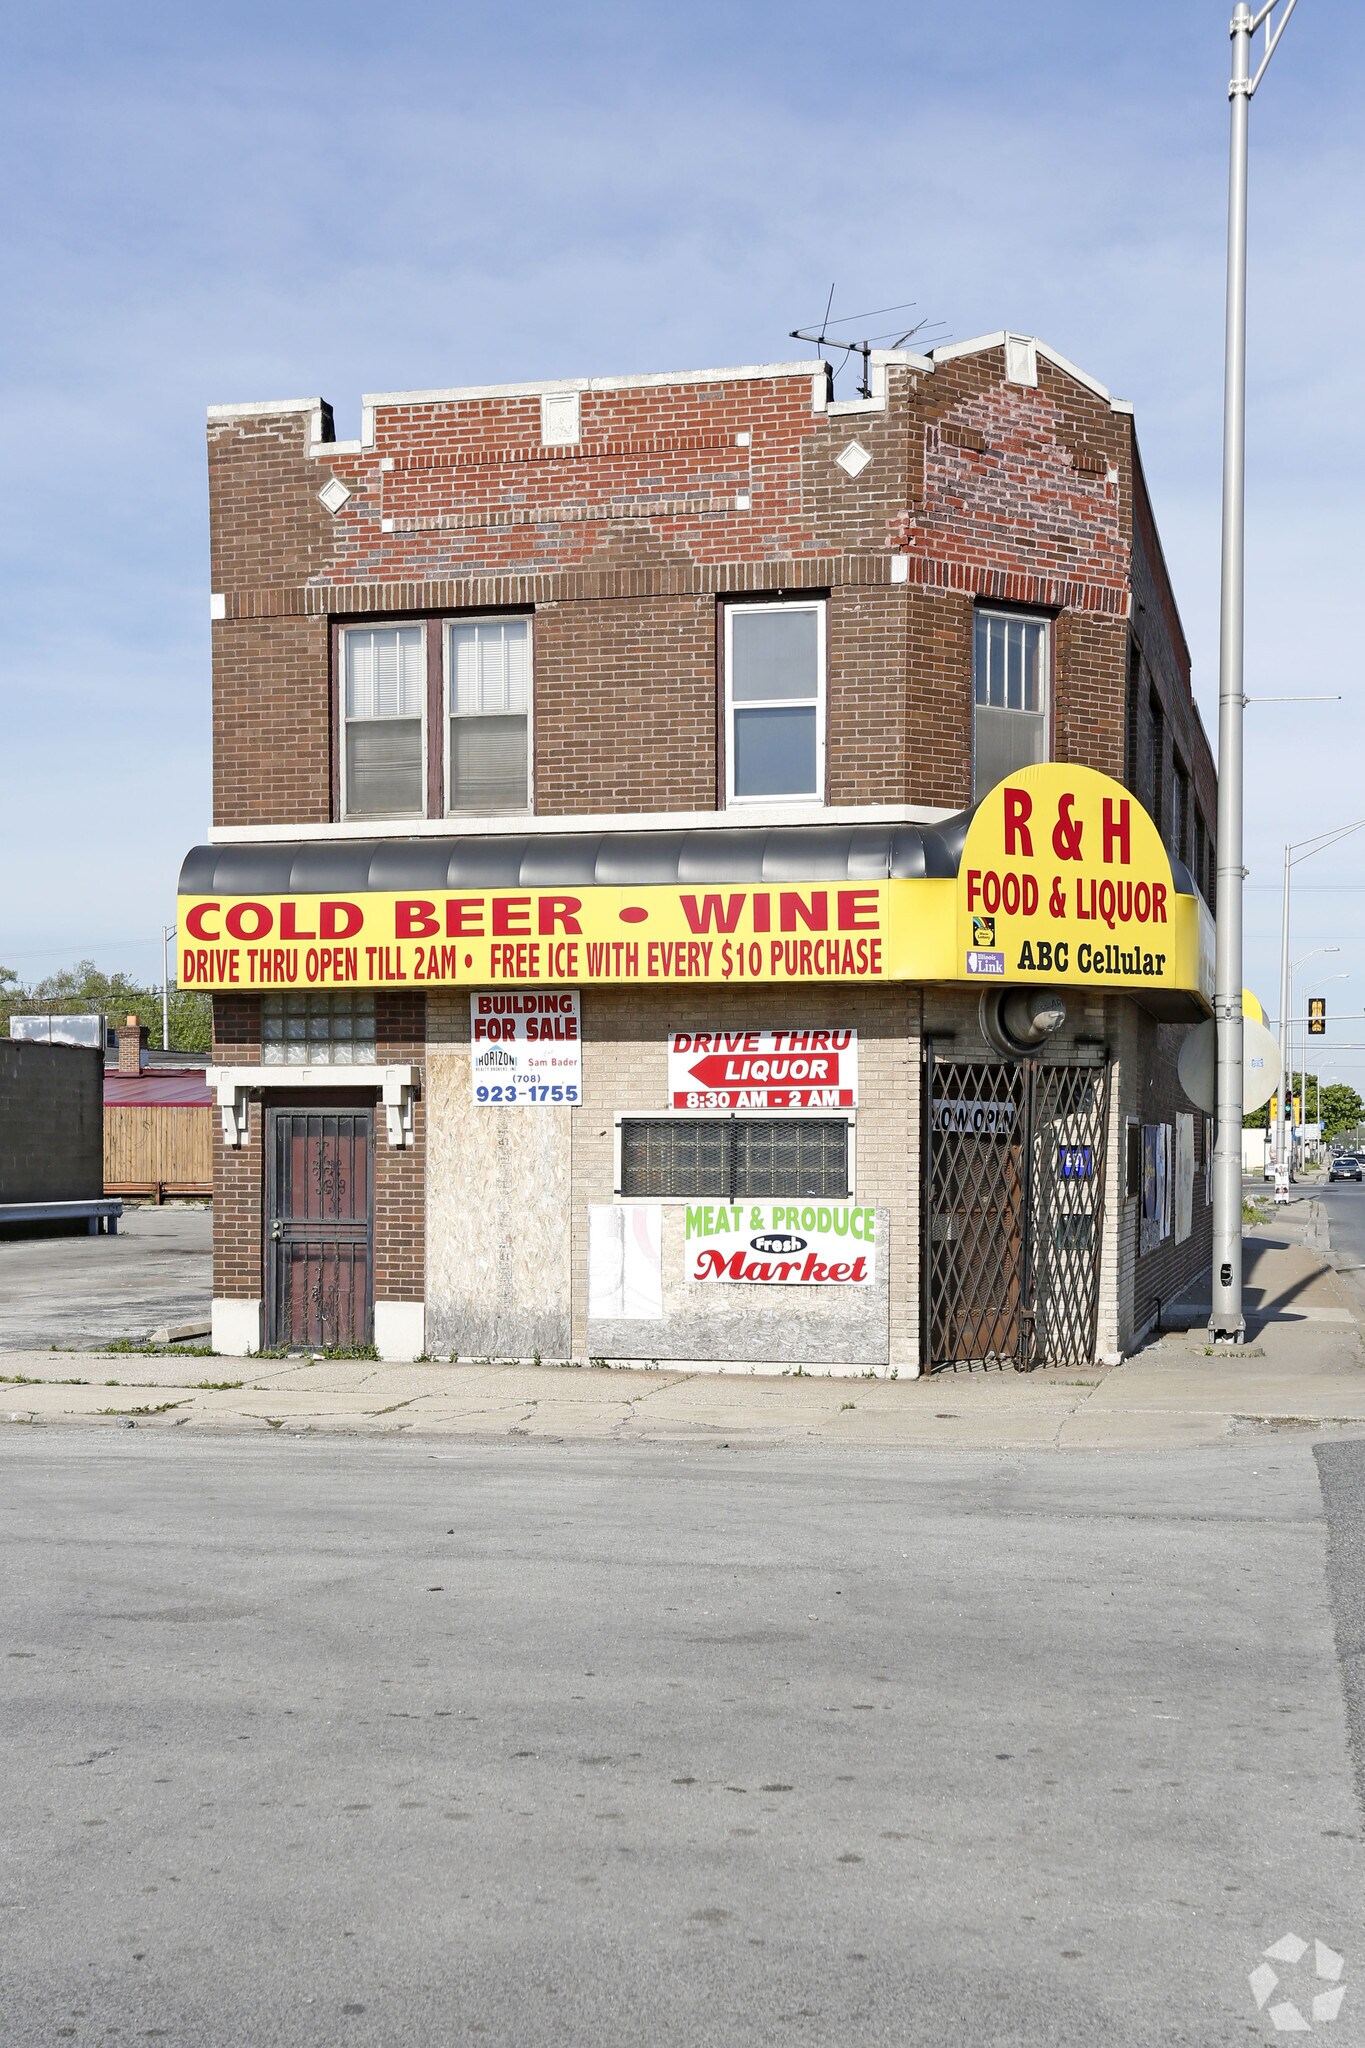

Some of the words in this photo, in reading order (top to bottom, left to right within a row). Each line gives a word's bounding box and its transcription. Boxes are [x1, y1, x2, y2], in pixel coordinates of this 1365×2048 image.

[1004, 788, 1034, 857] R
[1052, 793, 1083, 861] &
[1102, 798, 1130, 864] H
[967, 869, 1039, 916] FOOD
[1049, 876, 1066, 918] &
[1076, 878, 1167, 930] LIQUOR
[185, 901, 364, 941] COLD
[395, 896, 583, 939] BEER
[679, 889, 880, 934] WINE
[184, 949, 239, 982] DRIVE
[247, 949, 298, 982] THRU
[306, 947, 358, 982] OPEN
[365, 946, 407, 981] TILL
[414, 945, 456, 980] 2AM
[490, 943, 540, 978] FREE
[548, 942, 578, 977] ICE
[586, 942, 639, 977] WITH
[648, 941, 713, 977] EVERY
[721, 939, 762, 979] $10
[771, 938, 882, 976] PURCHASE
[978, 960, 1003, 973] Link
[1017, 940, 1069, 972] ABC
[1077, 943, 1166, 975] Cellular
[478, 995, 573, 1014] BUILDING
[474, 1018, 516, 1042] FOR
[526, 1017, 577, 1042] SALE
[673, 1032, 761, 1053] DRIVE
[770, 1030, 851, 1051] THRU
[478, 1051, 515, 1066] HORIZON
[528, 1058, 547, 1066] Sam
[551, 1058, 578, 1066] Bader
[512, 1074, 541, 1084] (708)
[724, 1059, 829, 1082] LIQUOR
[476, 1085, 578, 1102] 923-1755
[686, 1091, 730, 1108] 8:30
[735, 1091, 768, 1108] AM
[788, 1091, 802, 1107] 2
[807, 1090, 840, 1106] AM
[685, 1206, 743, 1240] MEAT
[750, 1206, 765, 1230] &
[772, 1206, 875, 1243] PRODUCE
[755, 1237, 802, 1252] Fresh
[693, 1250, 868, 1282] Market
